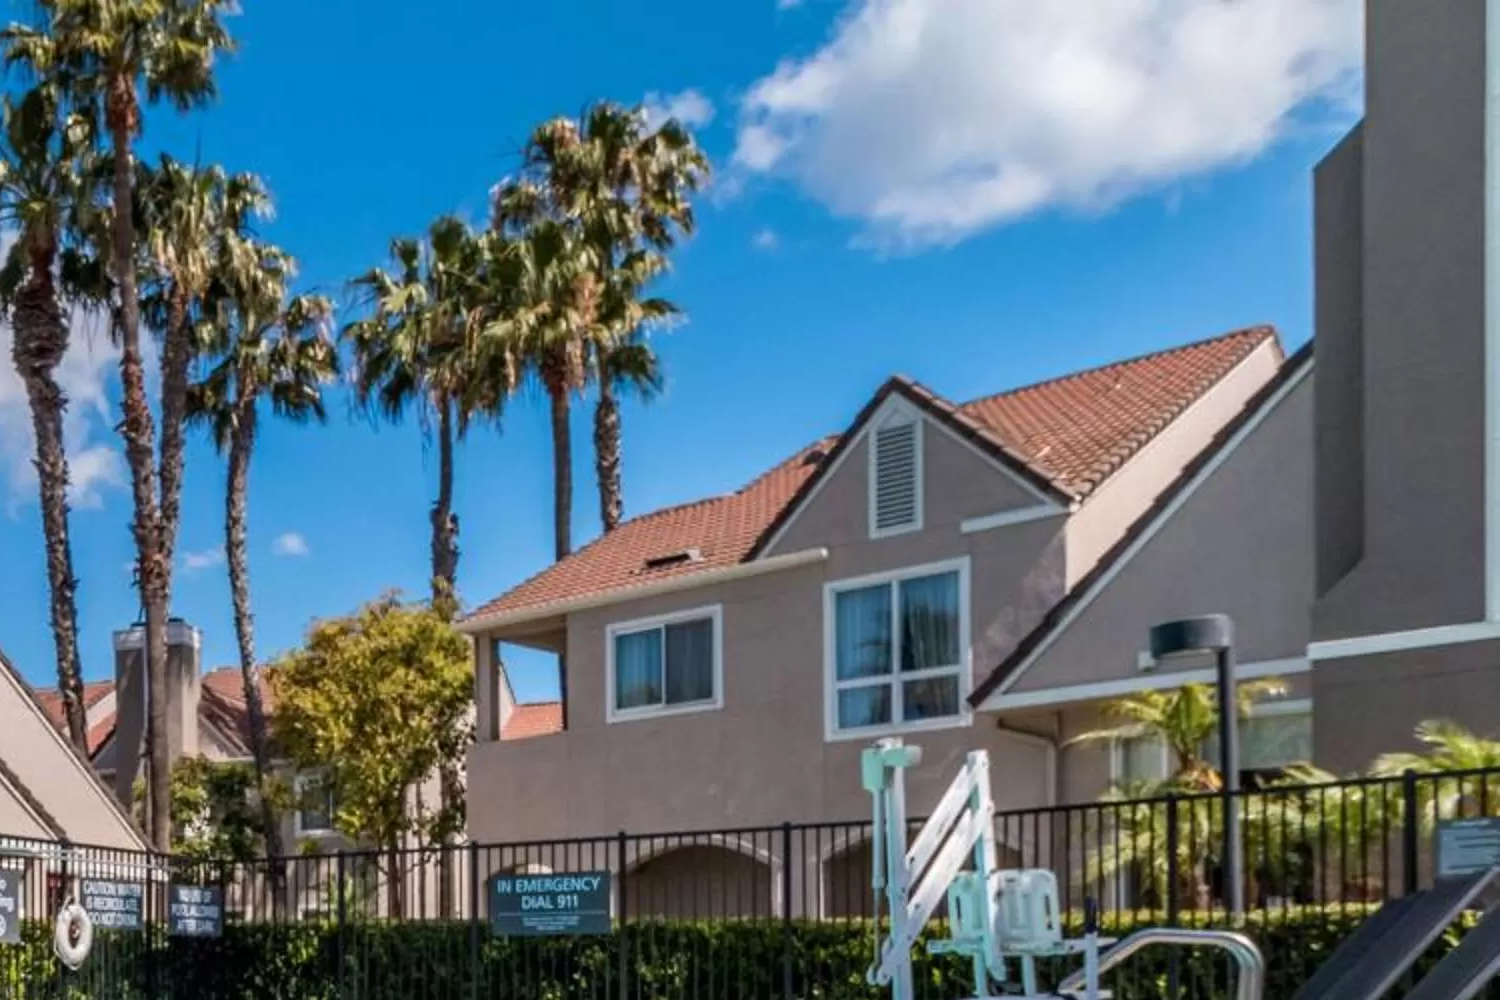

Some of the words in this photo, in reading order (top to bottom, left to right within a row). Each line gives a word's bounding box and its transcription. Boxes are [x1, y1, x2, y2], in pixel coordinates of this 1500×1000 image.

[497, 879, 511, 893] IN
[515, 876, 600, 893] EMERGENCY
[521, 895, 554, 909] DIAL
[557, 894, 579, 909] 911
